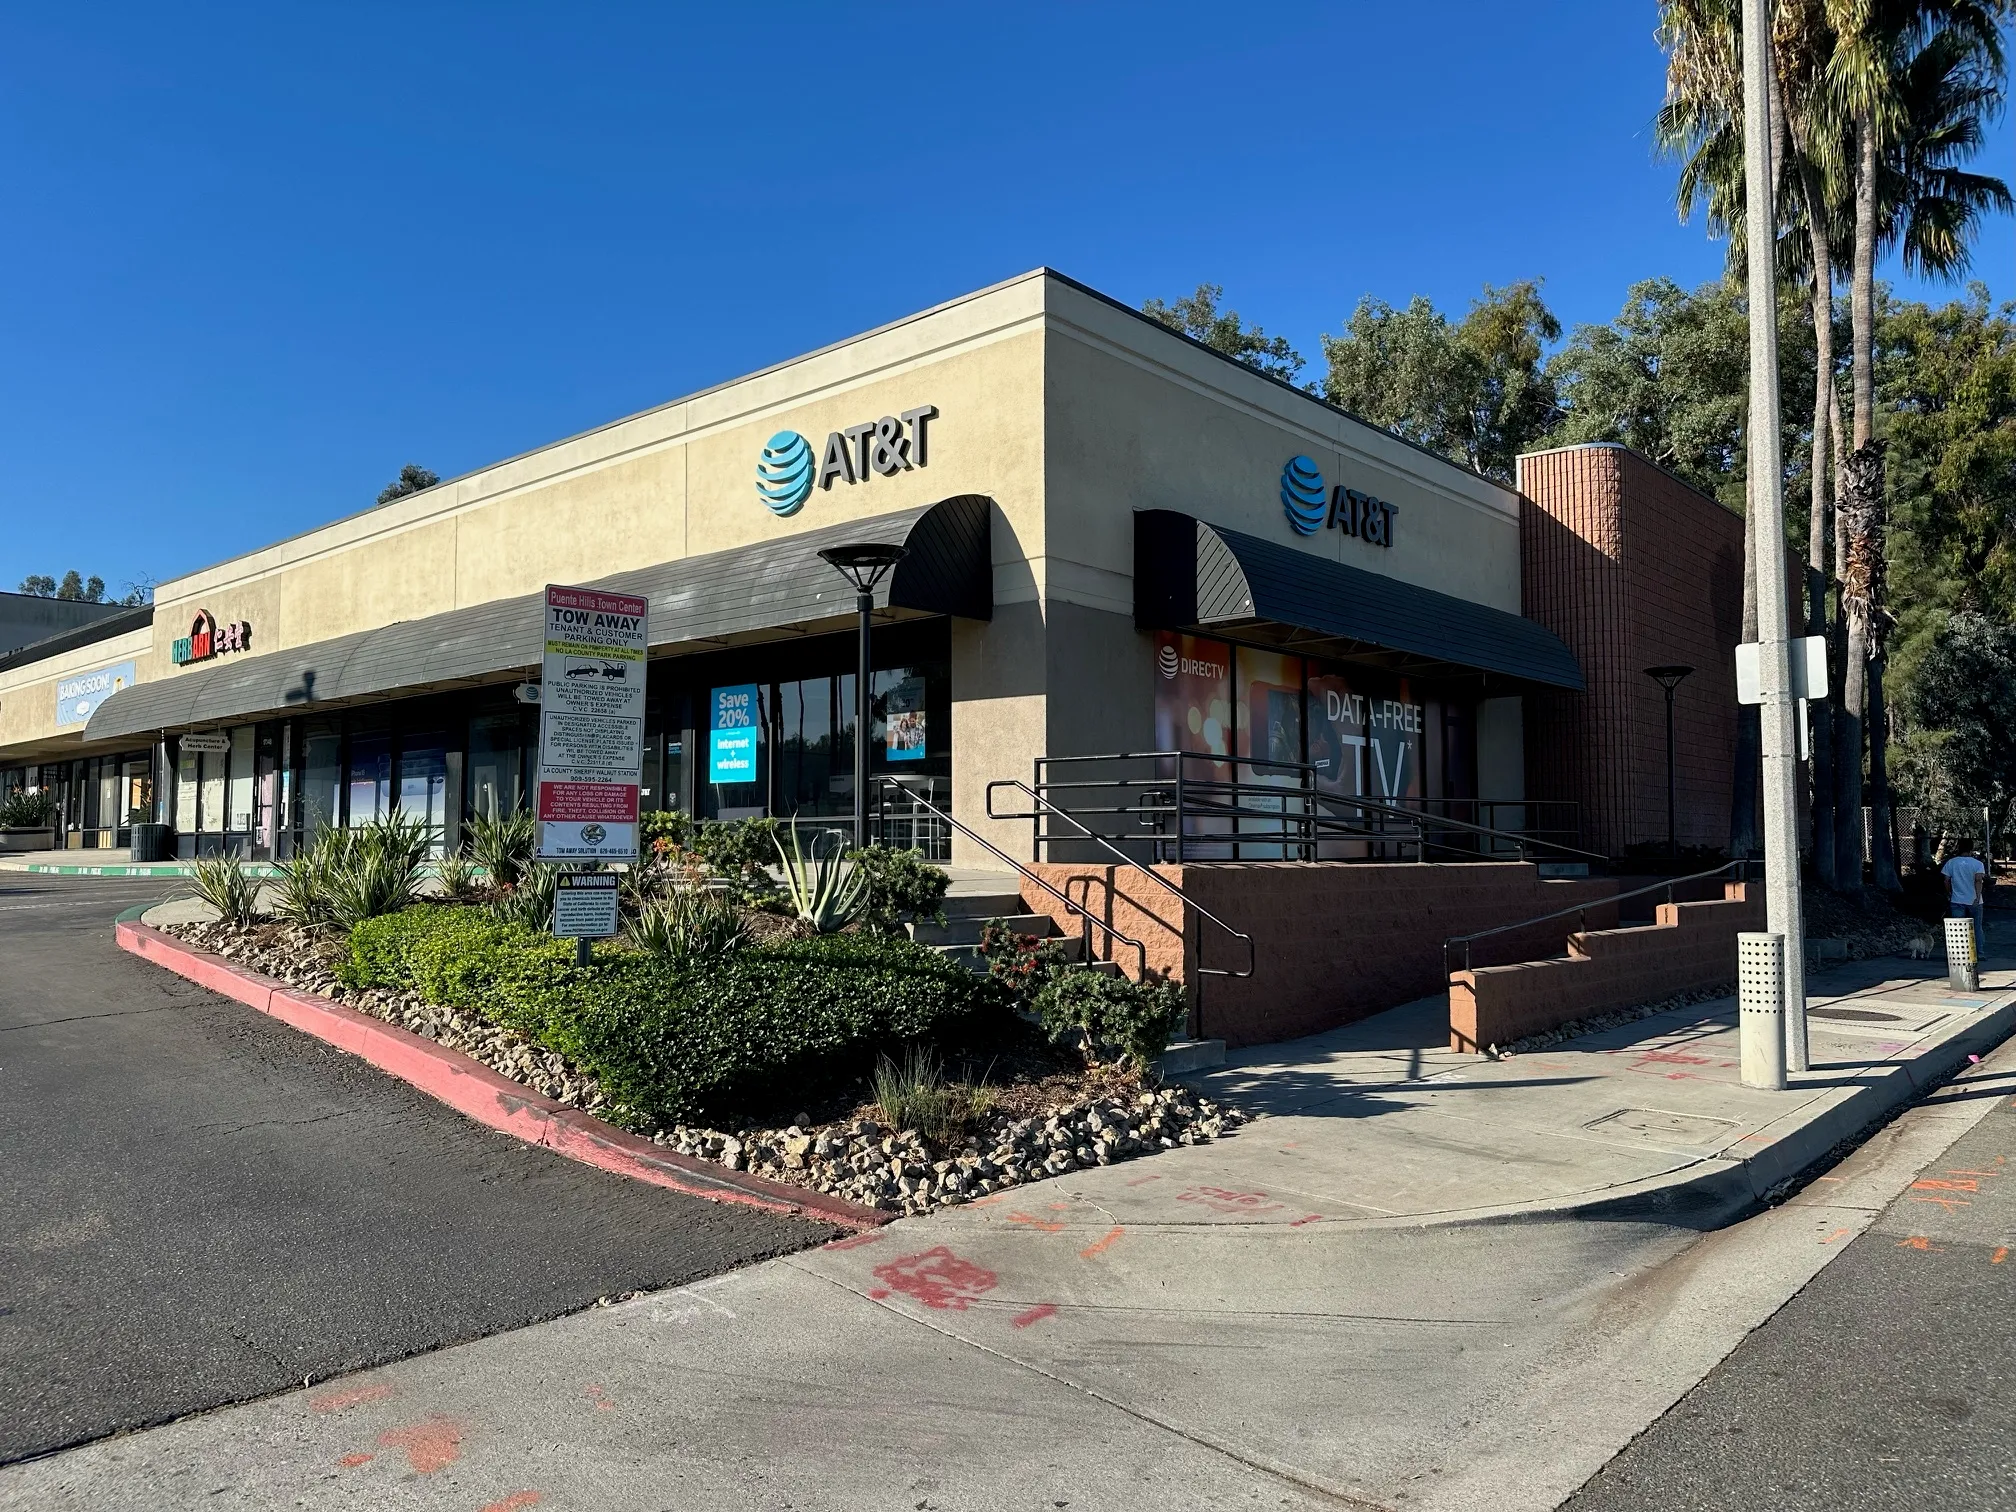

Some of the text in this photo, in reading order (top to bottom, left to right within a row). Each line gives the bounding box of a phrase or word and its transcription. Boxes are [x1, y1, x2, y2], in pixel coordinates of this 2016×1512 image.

[818, 404, 938, 490] AT&T
[1327, 485, 1399, 547] AT&T
[551, 591, 643, 615] Puente Hills Town Center
[552, 607, 641, 632] TOW AWAY
[549, 622, 643, 642] TENANT & CUSTOMER
[565, 633, 629, 648] PARKING ONLY
[573, 649, 596, 657] COUNTY
[613, 654, 636, 662] PARKING
[1181, 657, 1224, 680] DIRECTV
[60, 673, 110, 701] BAKING SOON!
[556, 687, 603, 696] UNAUTHORIZED
[572, 682, 598, 690] PARKING
[607, 685, 641, 694] PROHIBITED
[718, 692, 748, 709] Save
[718, 708, 750, 728] 20%
[717, 738, 750, 750] internet
[716, 758, 750, 770] wireless
[572, 876, 616, 886] WARNING
